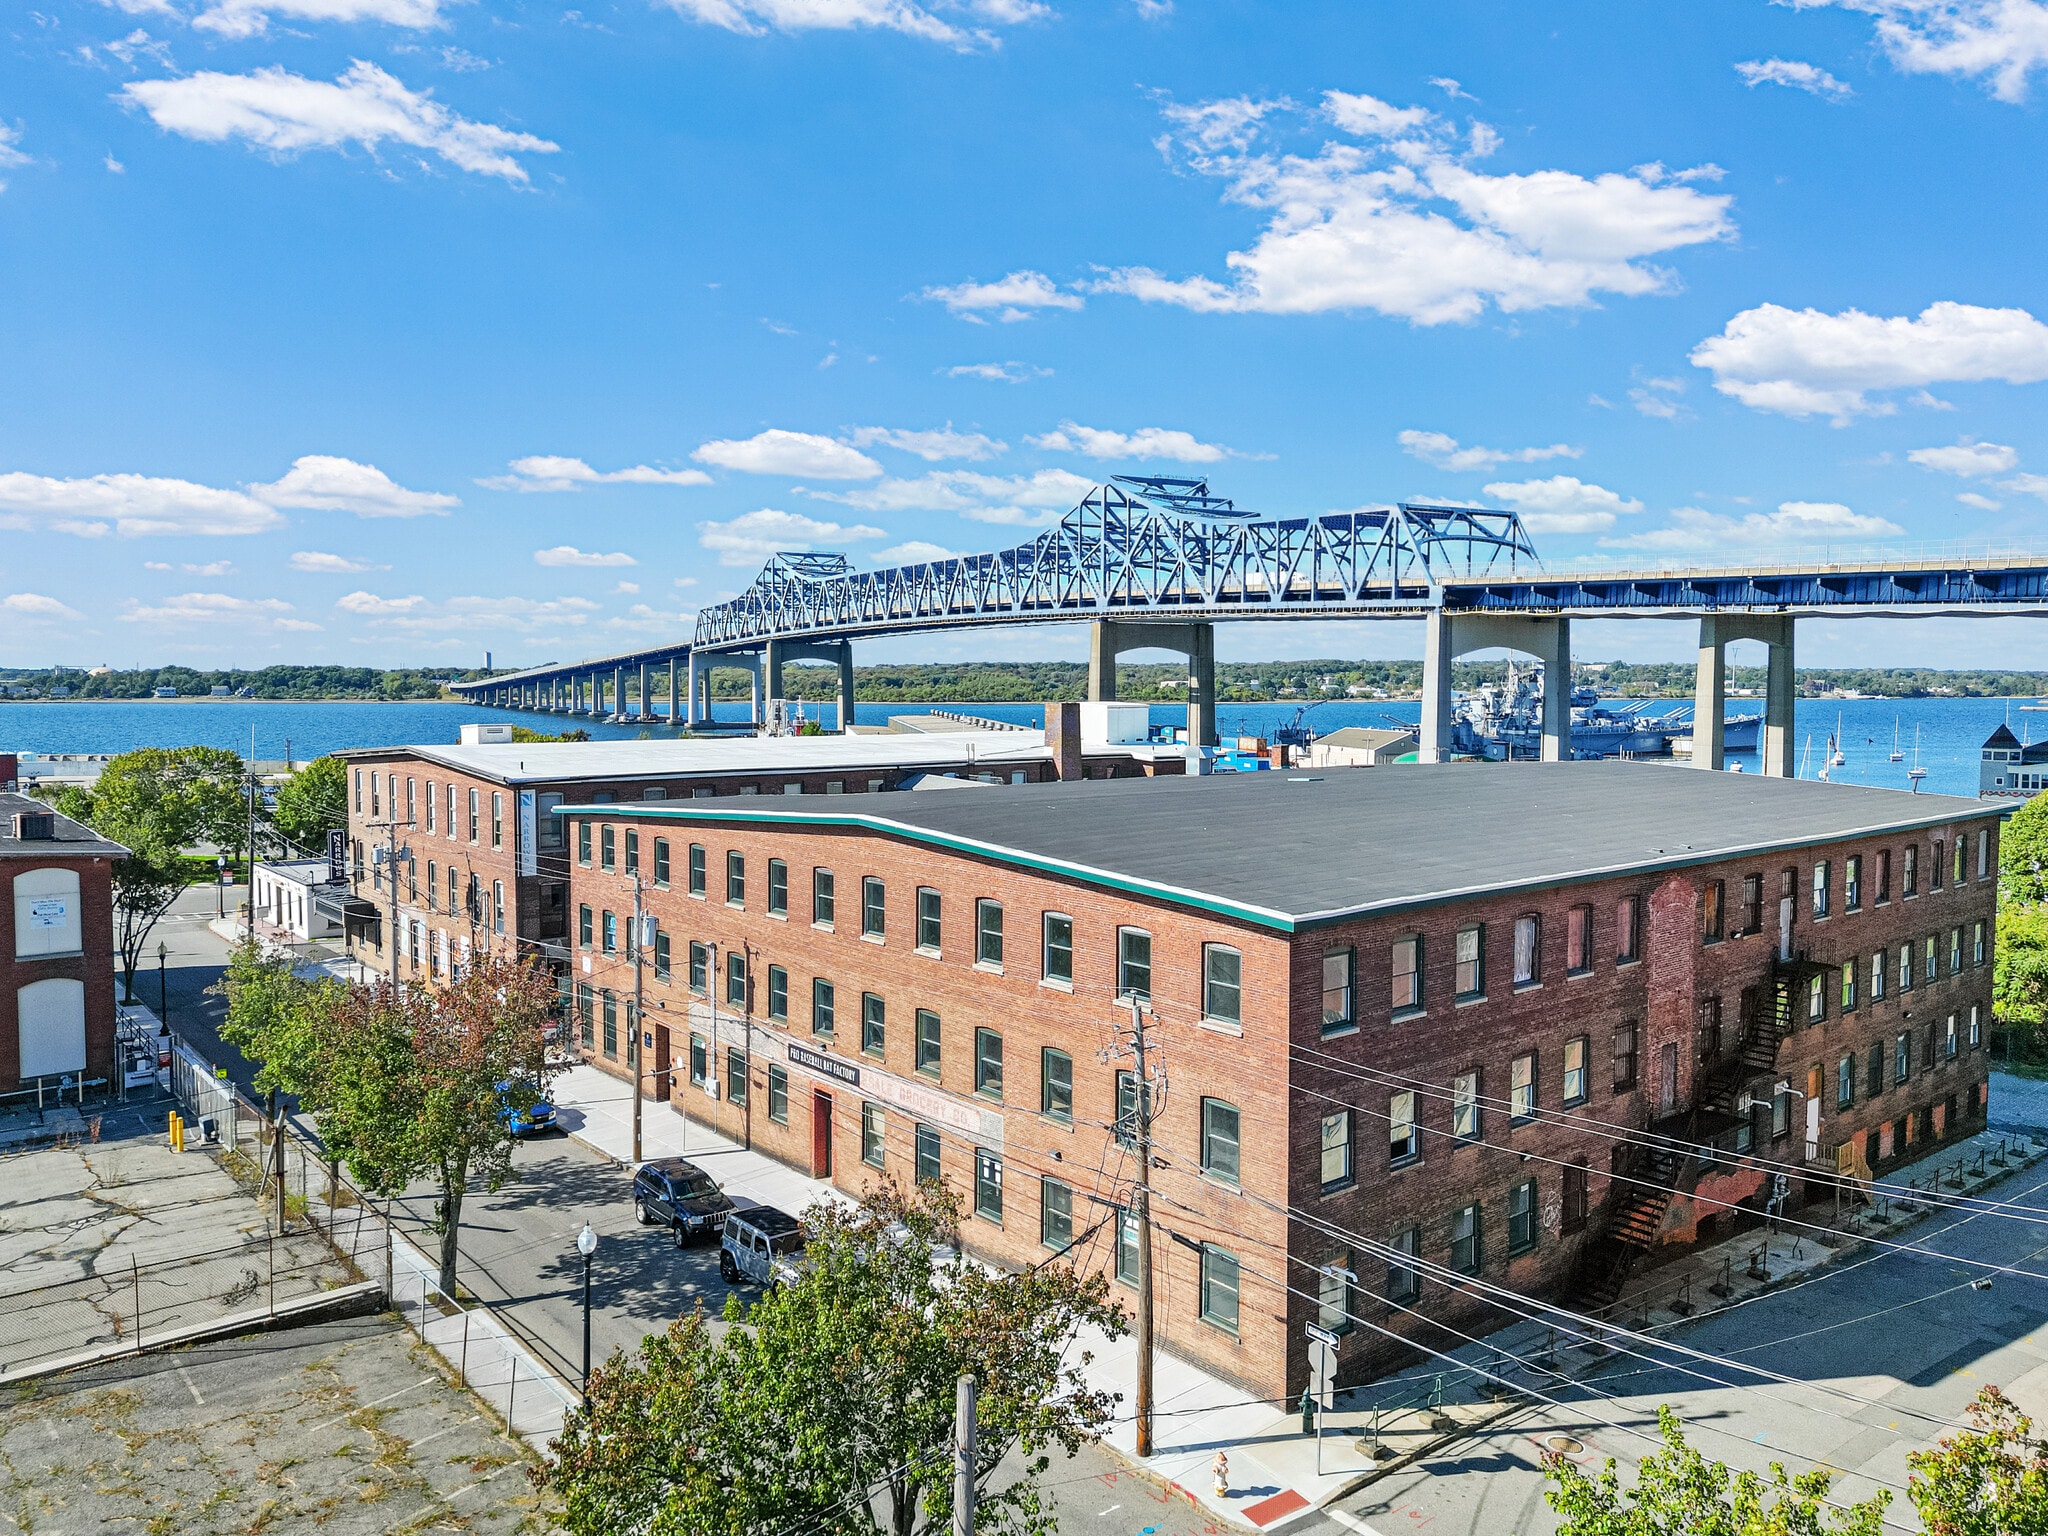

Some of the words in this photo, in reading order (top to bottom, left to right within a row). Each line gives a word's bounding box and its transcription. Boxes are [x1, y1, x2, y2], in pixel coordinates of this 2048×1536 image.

[333, 834, 343, 877] NARROWS
[522, 814, 531, 864] NARROWS
[790, 1047, 800, 1061] PRO
[800, 1051, 823, 1069] BASEBALL
[823, 1059, 833, 1073] BAT
[833, 1063, 856, 1081] FACTORY
[899, 1086, 947, 1119] GROCERY
